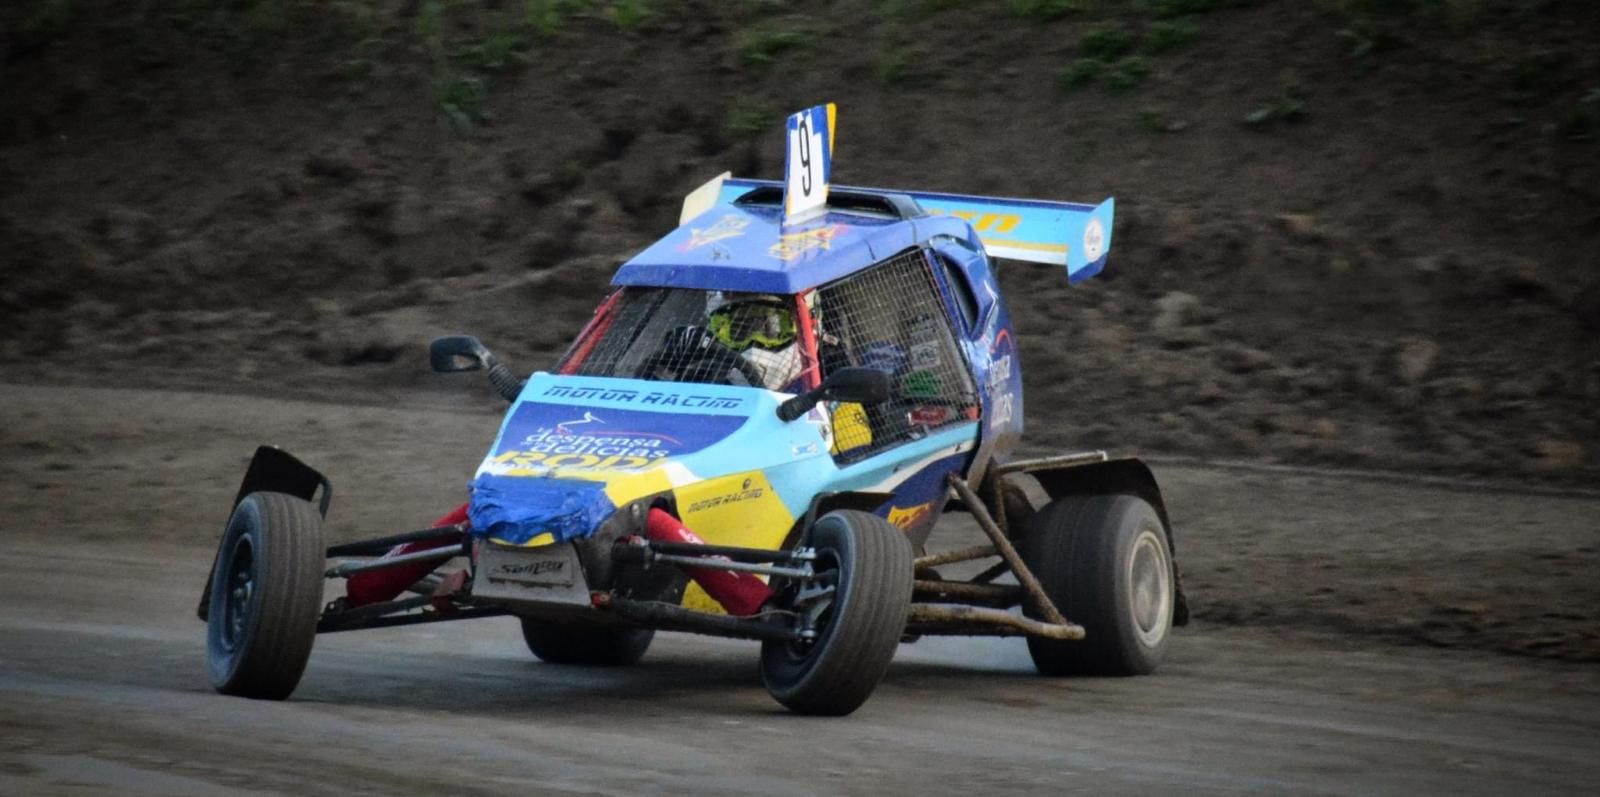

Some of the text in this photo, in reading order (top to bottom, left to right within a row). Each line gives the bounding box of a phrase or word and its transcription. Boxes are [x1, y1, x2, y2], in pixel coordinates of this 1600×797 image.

[797, 118, 812, 198] 9
[544, 385, 742, 409] MOTOR RACING
[525, 428, 663, 449] despensa
[529, 440, 671, 459] delicias
[687, 488, 764, 514] MOTOR RACING
